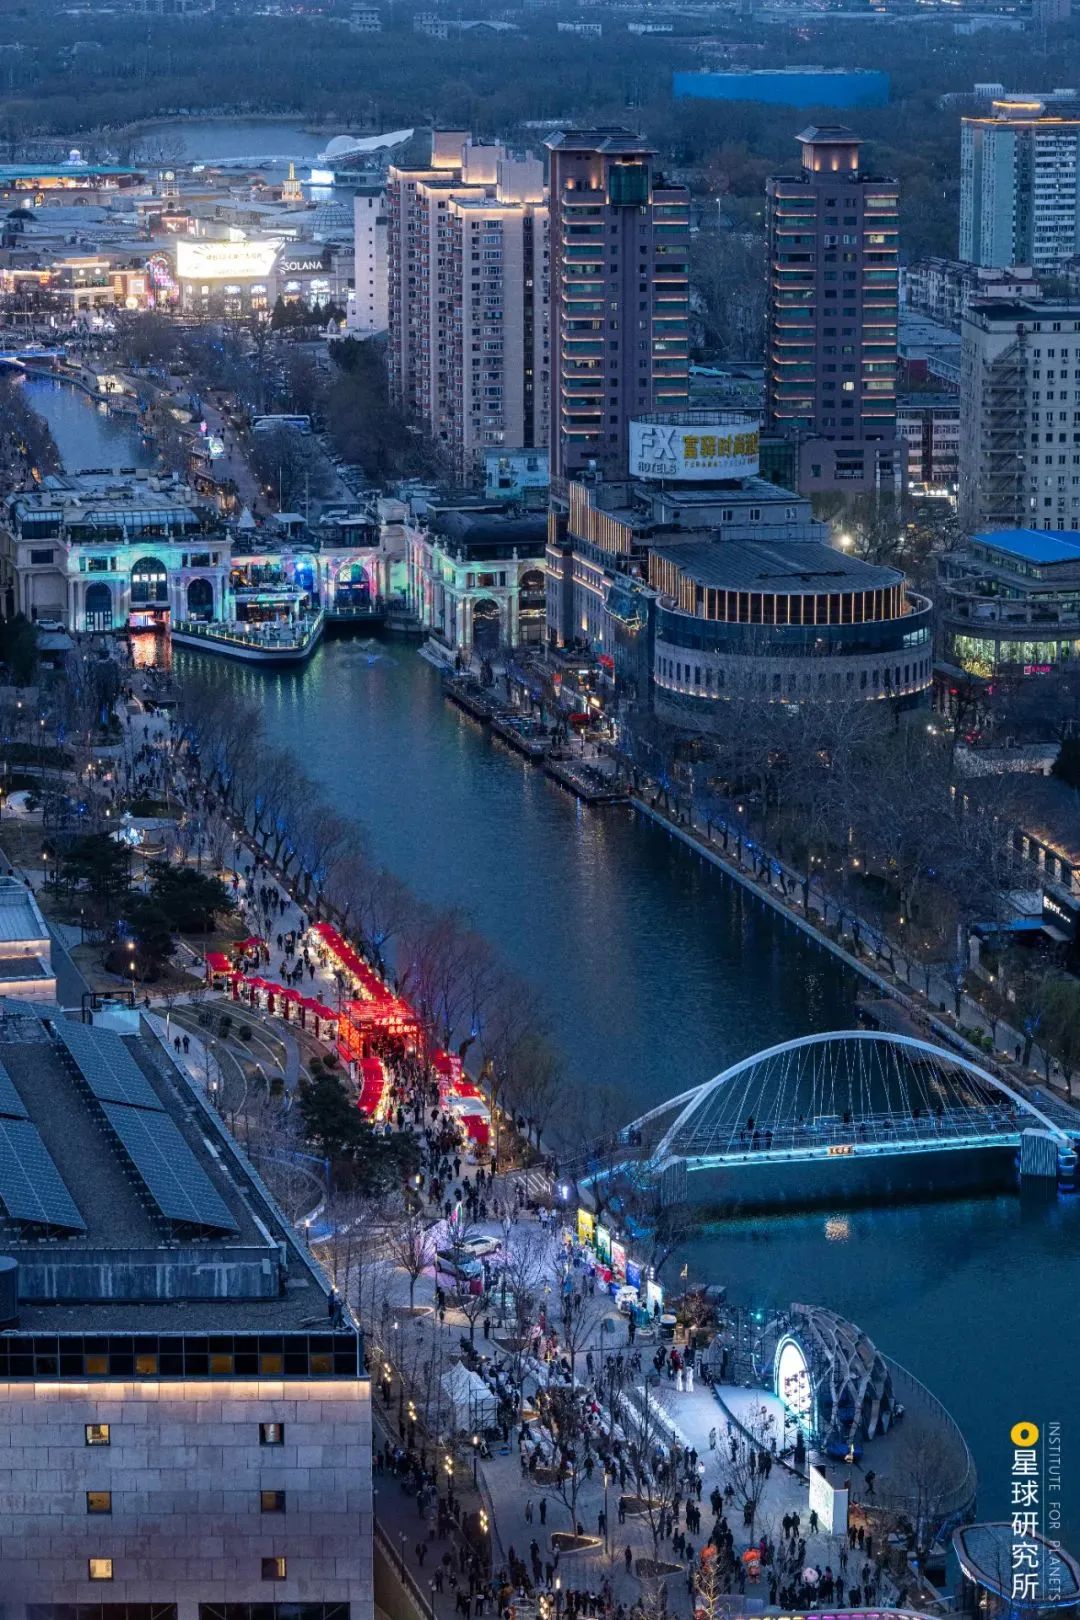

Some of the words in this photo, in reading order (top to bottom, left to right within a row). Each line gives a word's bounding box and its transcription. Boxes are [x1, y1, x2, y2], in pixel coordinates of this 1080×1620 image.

[284, 261, 323, 271] SOLANA
[638, 427, 677, 460] FX
[638, 462, 677, 475] HOTELS
